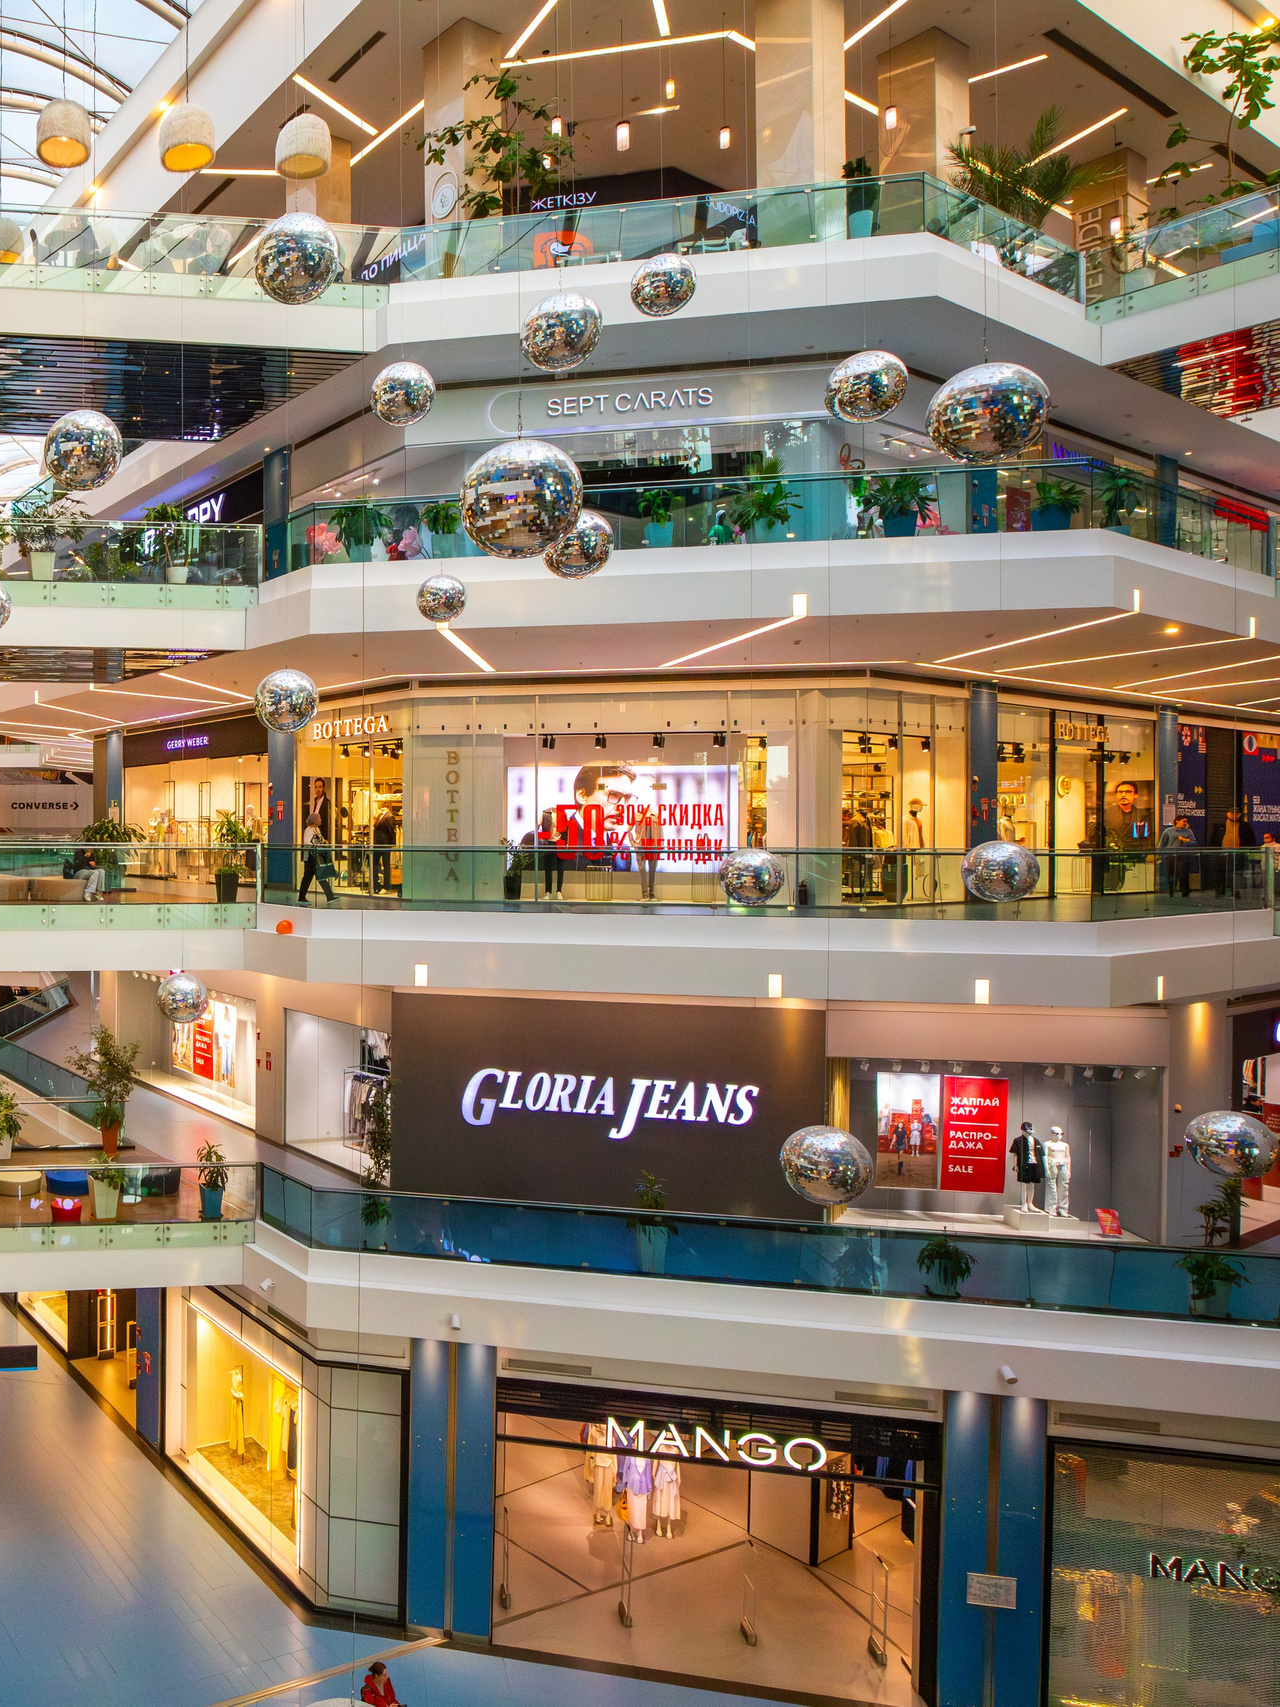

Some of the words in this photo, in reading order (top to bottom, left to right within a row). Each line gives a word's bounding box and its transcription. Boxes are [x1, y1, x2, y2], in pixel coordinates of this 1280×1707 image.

[380, 230, 426, 272] ПИЦЦА
[547, 394, 609, 417] SEPT
[615, 387, 713, 412] CARATS
[312, 714, 389, 740] BOTTEGA
[1057, 722, 1110, 743] BOTTEGA
[166, 739, 186, 750] GERRY
[187, 736, 208, 747] WEBER
[11, 802, 68, 810] CONVERSE
[445, 750, 461, 882] BOTTEGA
[658, 804, 724, 830] СКИДКА
[461, 1068, 615, 1126] GLORIA
[608, 1078, 760, 1140] JEANS
[950, 1096, 1000, 1107] ЖАППАЙ
[950, 1106, 978, 1115] САТУ
[948, 1140, 984, 1150] ДАЖА
[949, 1130, 998, 1141] РАСПРО-
[948, 1164, 974, 1174] SALE
[606, 1416, 827, 1472] MANGO
